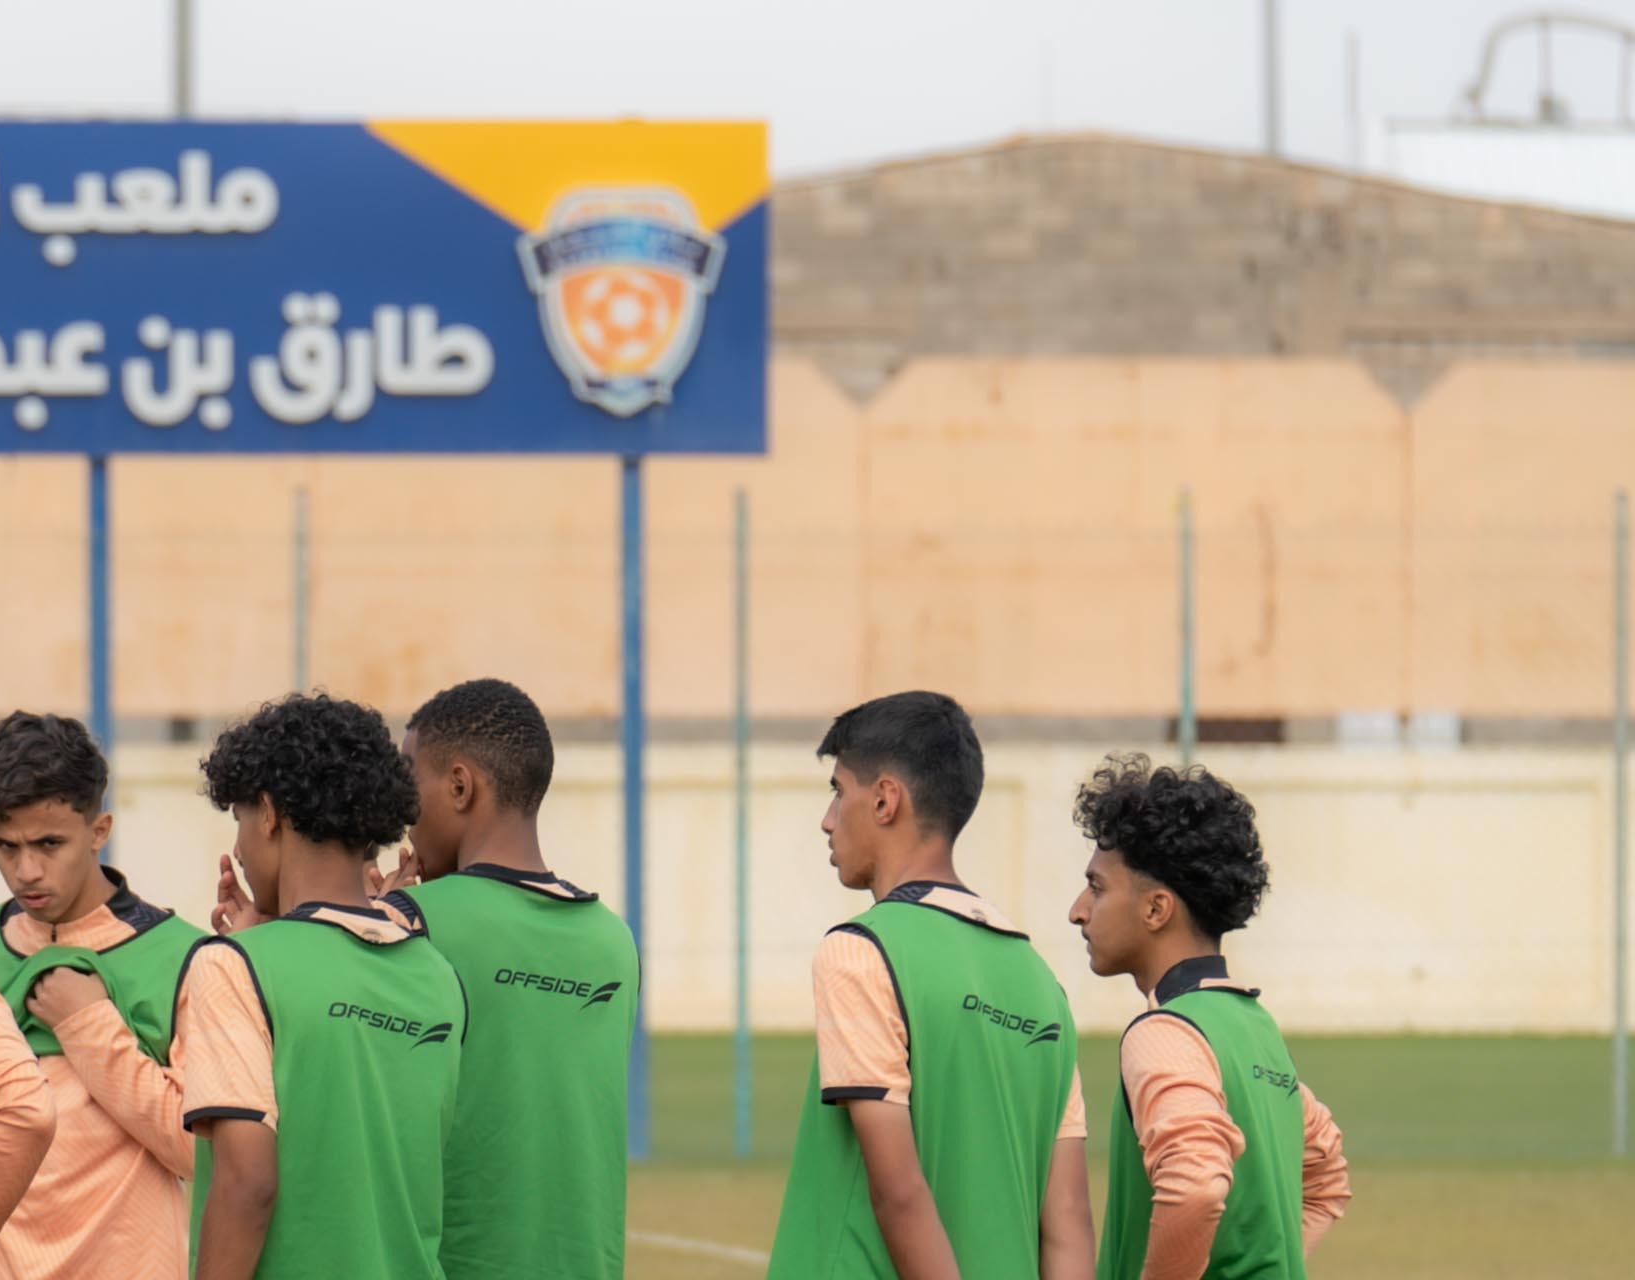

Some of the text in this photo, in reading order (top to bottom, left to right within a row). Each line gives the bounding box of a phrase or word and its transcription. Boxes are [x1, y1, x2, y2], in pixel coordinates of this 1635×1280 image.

[10, 149, 280, 267] ملعب
[121, 315, 235, 431] بن
[248, 291, 496, 425] طارق
[328, 1002, 423, 1037] OFFSIDE
[494, 968, 592, 998] OFFSIDE
